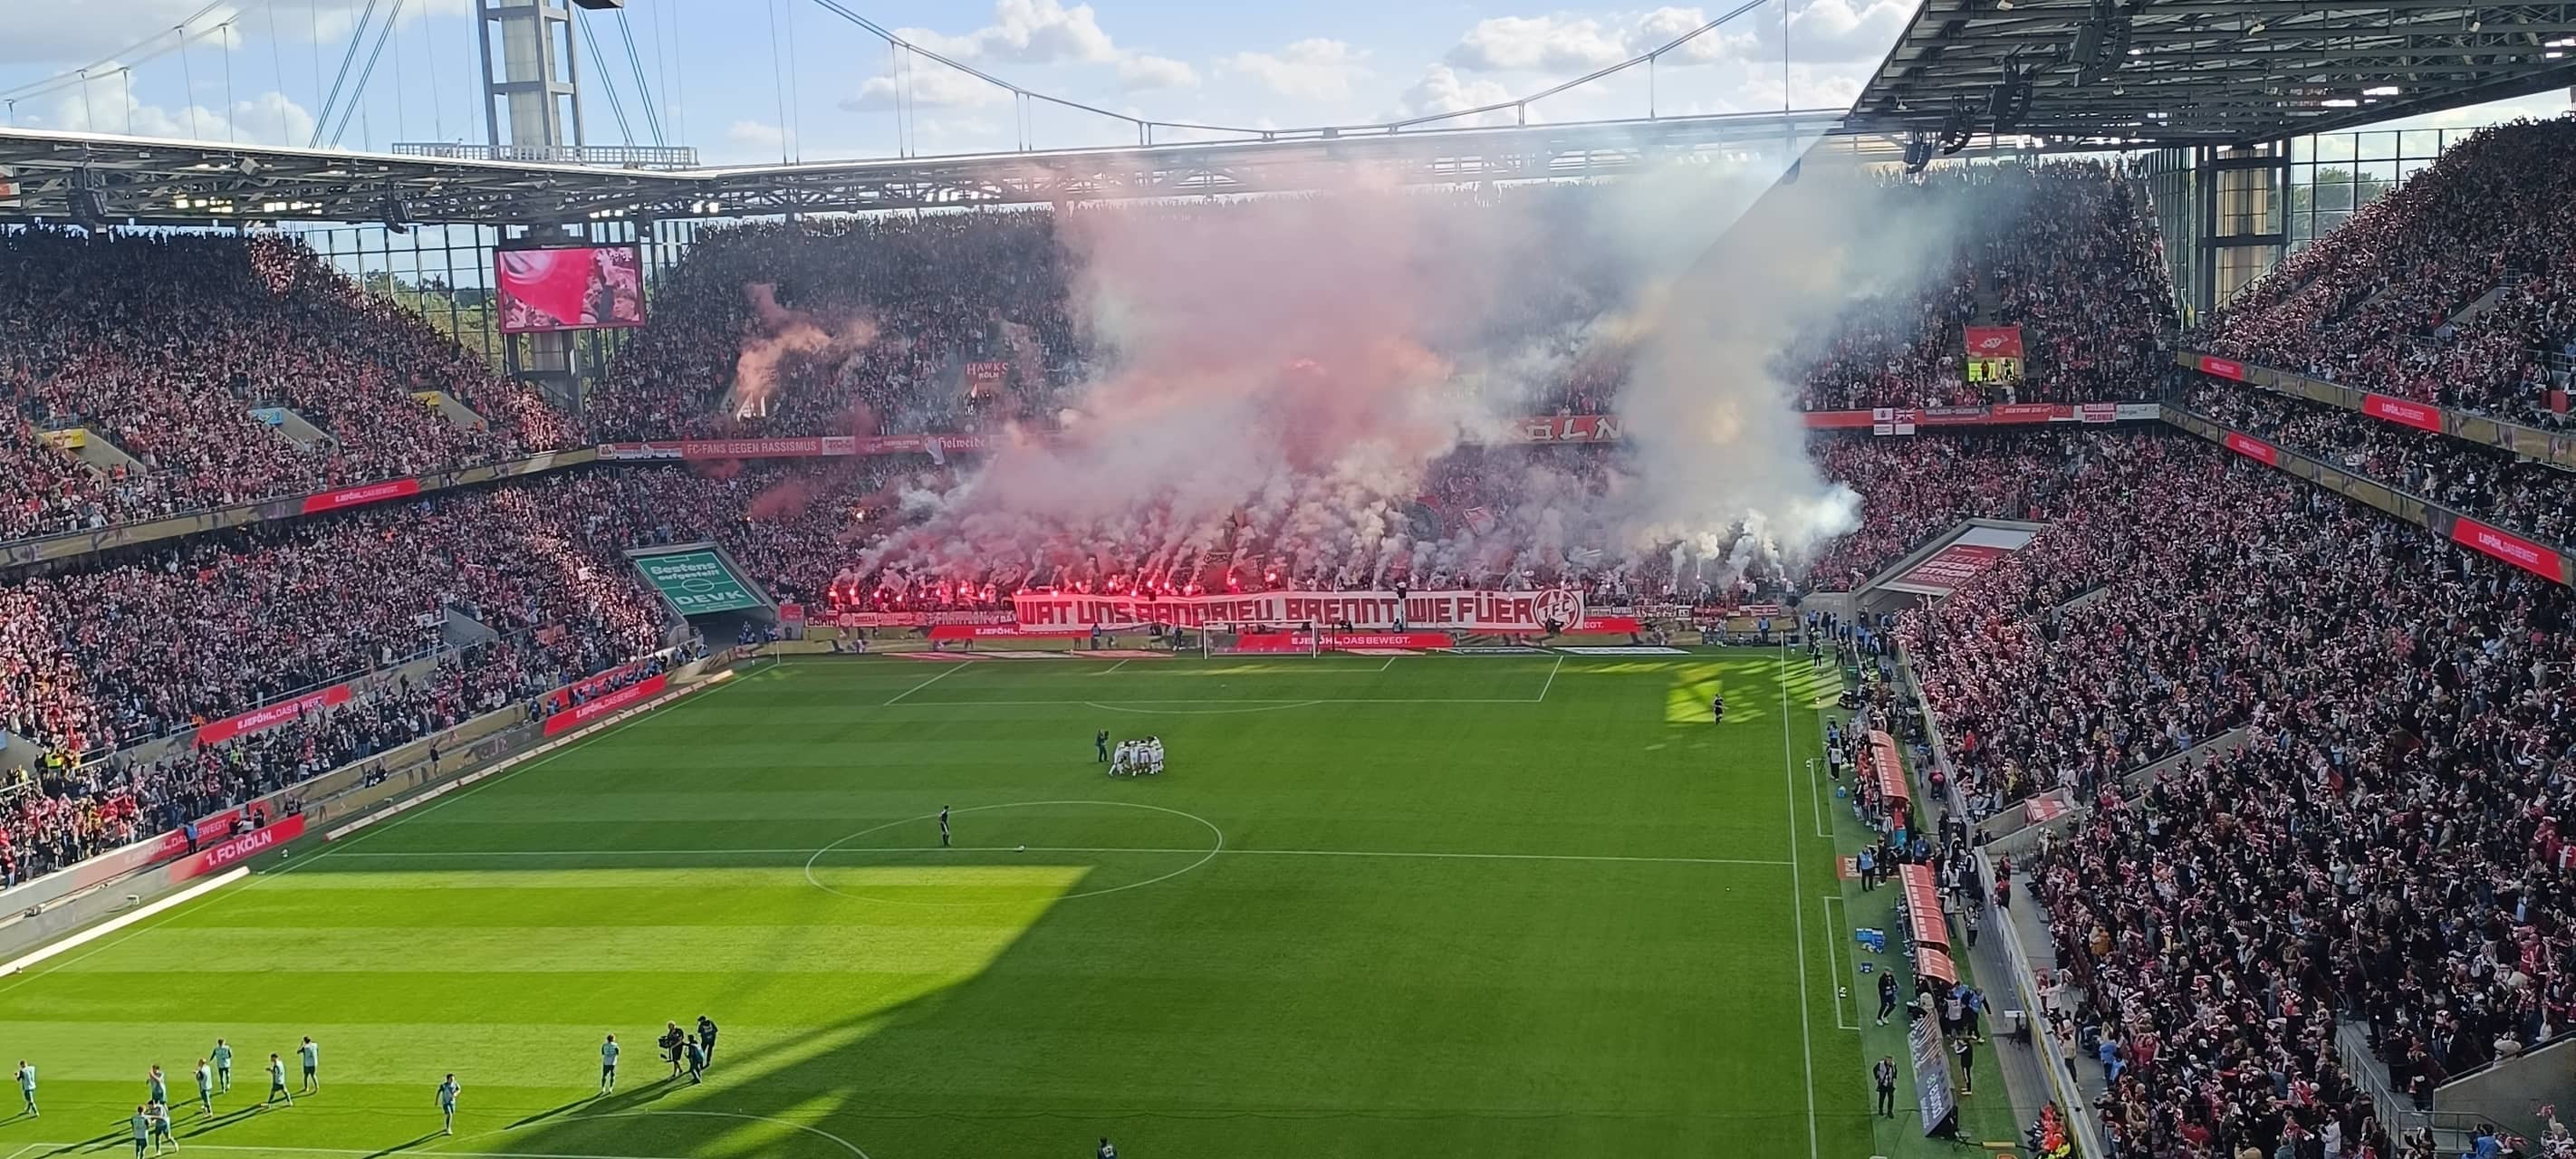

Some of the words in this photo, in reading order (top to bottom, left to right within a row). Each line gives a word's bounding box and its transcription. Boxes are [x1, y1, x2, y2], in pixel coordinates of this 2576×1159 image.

[966, 362, 1009, 376] HAWKS
[687, 443, 726, 455] FC-FANS
[728, 442, 760, 454] GEGEN
[762, 440, 817, 453] RASSISMUS
[650, 562, 716, 575] Bestens
[658, 570, 720, 580] aufgestellt
[676, 590, 745, 605] DEVK
[1016, 600, 1072, 625] WAT
[1077, 600, 1132, 624] UNS
[1285, 598, 1399, 624] BRENNT
[1404, 598, 1452, 623] WIE
[1456, 591, 1534, 623] FÜER
[1365, 635, 1412, 646] BEWEGT.
[216, 846, 235, 863] FC
[235, 829, 272, 856] KÖLN
